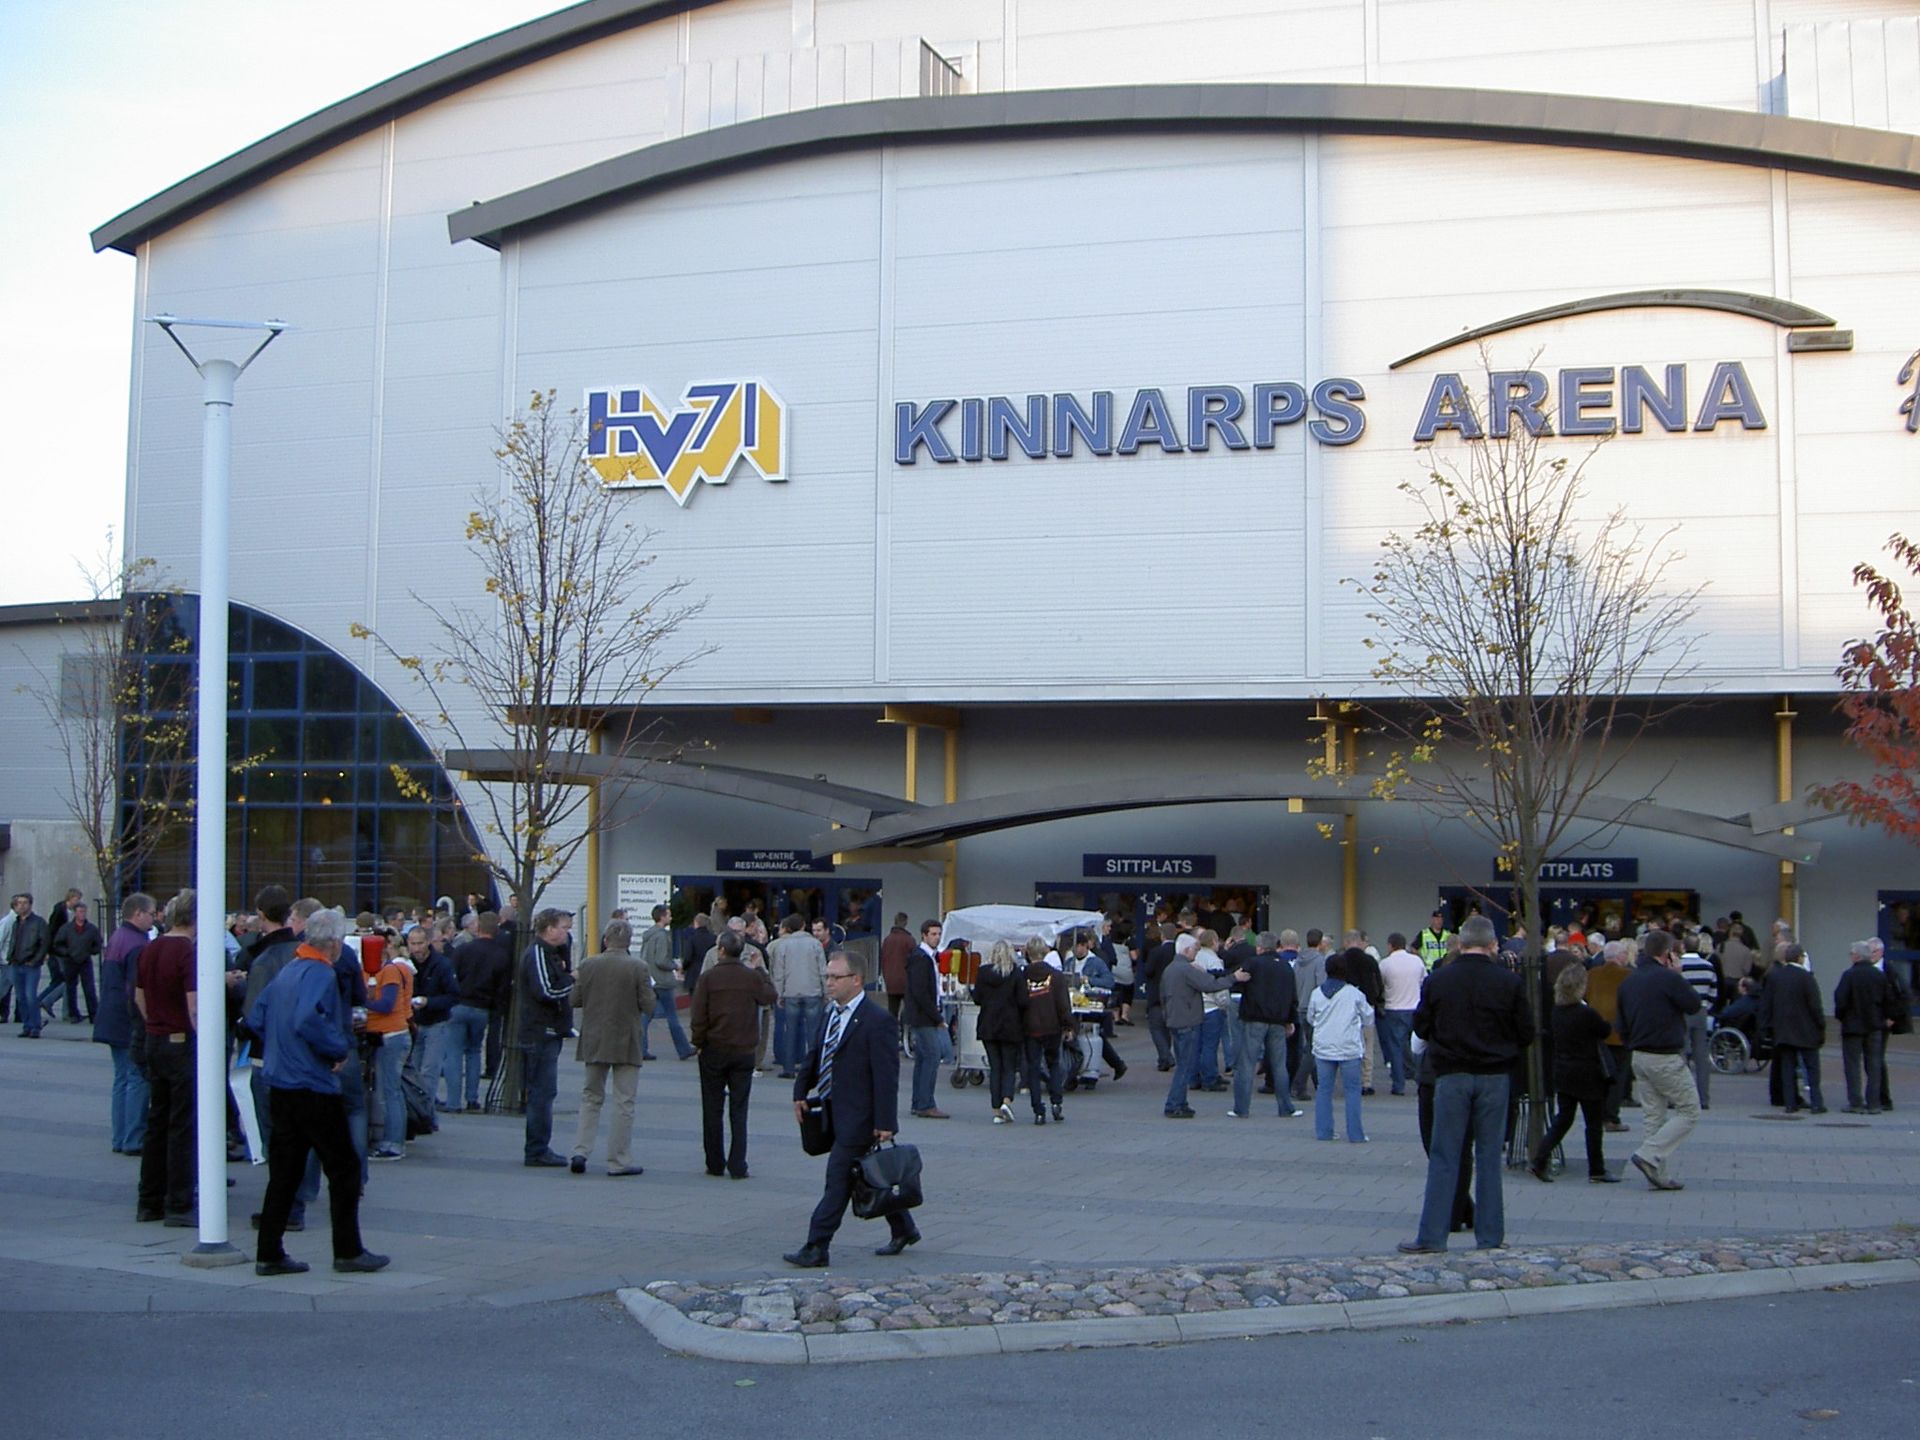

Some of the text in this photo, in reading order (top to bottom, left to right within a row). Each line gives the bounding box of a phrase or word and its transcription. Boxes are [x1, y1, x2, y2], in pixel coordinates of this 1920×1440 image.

[585, 380, 768, 485] HV71
[894, 361, 1768, 465] KINNARPS ARENA
[735, 861, 788, 870] RESTAURANG
[1106, 859, 1193, 874] SITTPLATS
